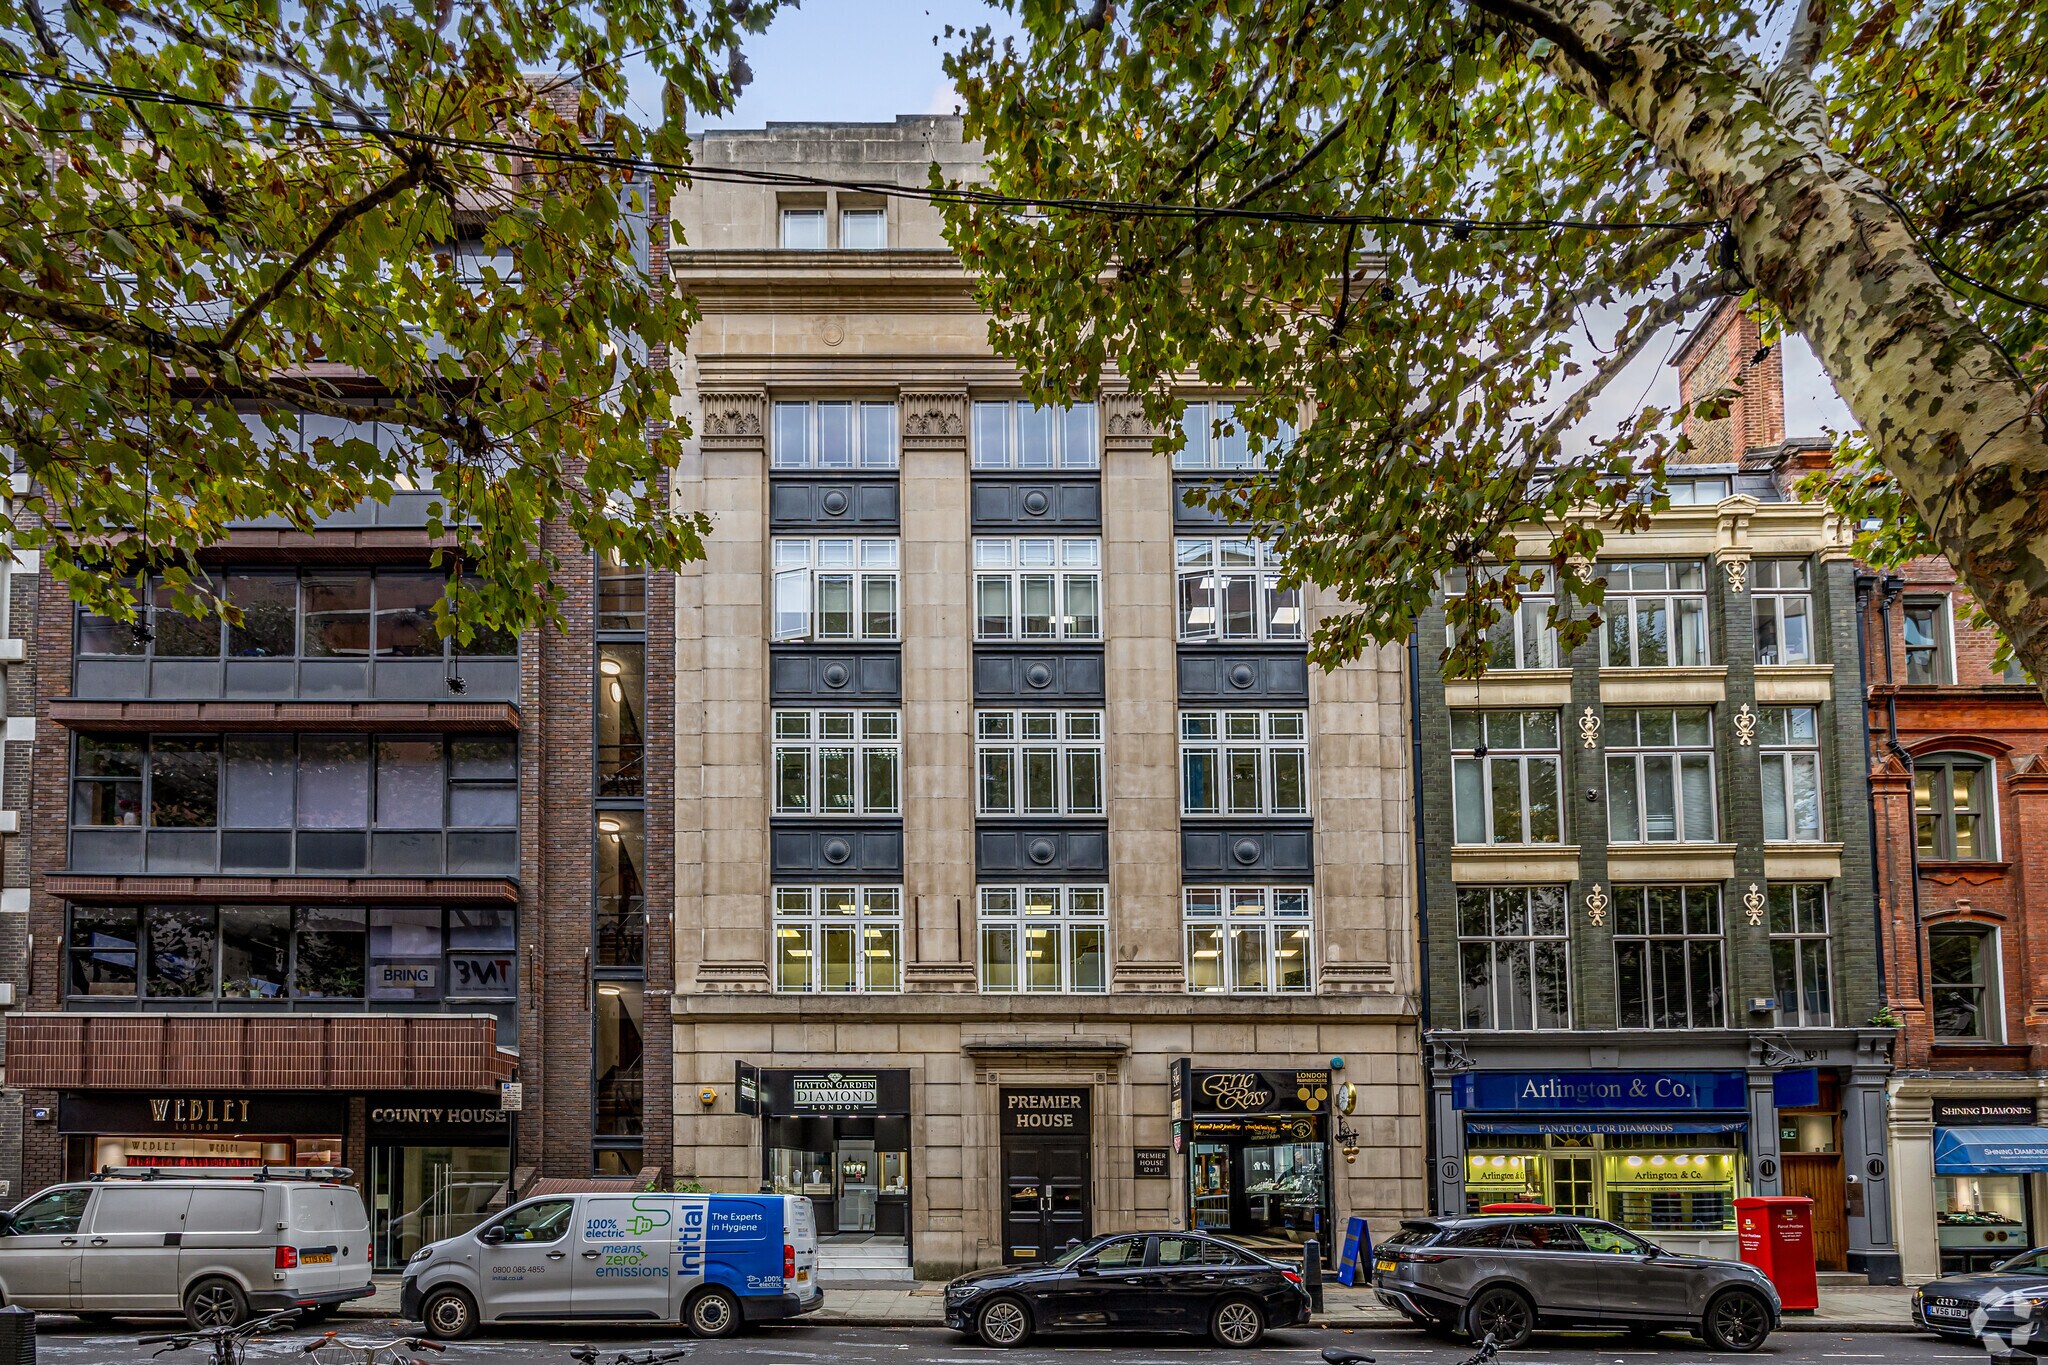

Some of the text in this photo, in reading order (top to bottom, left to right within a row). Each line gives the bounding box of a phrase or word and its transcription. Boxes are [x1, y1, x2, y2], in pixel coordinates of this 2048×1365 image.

[383, 969, 428, 981] BRING
[796, 1081, 874, 1089] HATTON GARDEN
[1202, 1073, 1255, 1096] Eric
[1521, 1078, 1691, 1102] Arlington & Co.
[797, 1090, 875, 1102] DIAMOND
[1216, 1087, 1268, 1110] Ross
[1008, 1095, 1082, 1109] PREMIER
[372, 1108, 507, 1123] COUNTY HOUSE
[1941, 1106, 2032, 1115] SHINING DIAMONDS
[1016, 1114, 1074, 1128] HOUSE
[175, 1123, 219, 1131] LONDON
[1539, 1124, 1674, 1133] FANATICAL FOR DIAMONDS
[1984, 1148, 2013, 1156] SHINING
[1447, 1165, 1454, 1176] 11
[1480, 1171, 1514, 1181] Arlington
[1635, 1171, 1678, 1180] Arlington
[1690, 1170, 1703, 1179] Co.
[712, 1212, 763, 1223] The Experts
[587, 1219, 617, 1229] 100%
[711, 1223, 758, 1233] in Hygiene
[585, 1229, 625, 1238] electric
[677, 1204, 704, 1276] Initial
[601, 1245, 642, 1254] means
[605, 1255, 639, 1266] zero
[527, 1265, 545, 1273] 4855
[595, 1264, 669, 1277] emissions
[1931, 1305, 1967, 1318] LV56 UBJ
